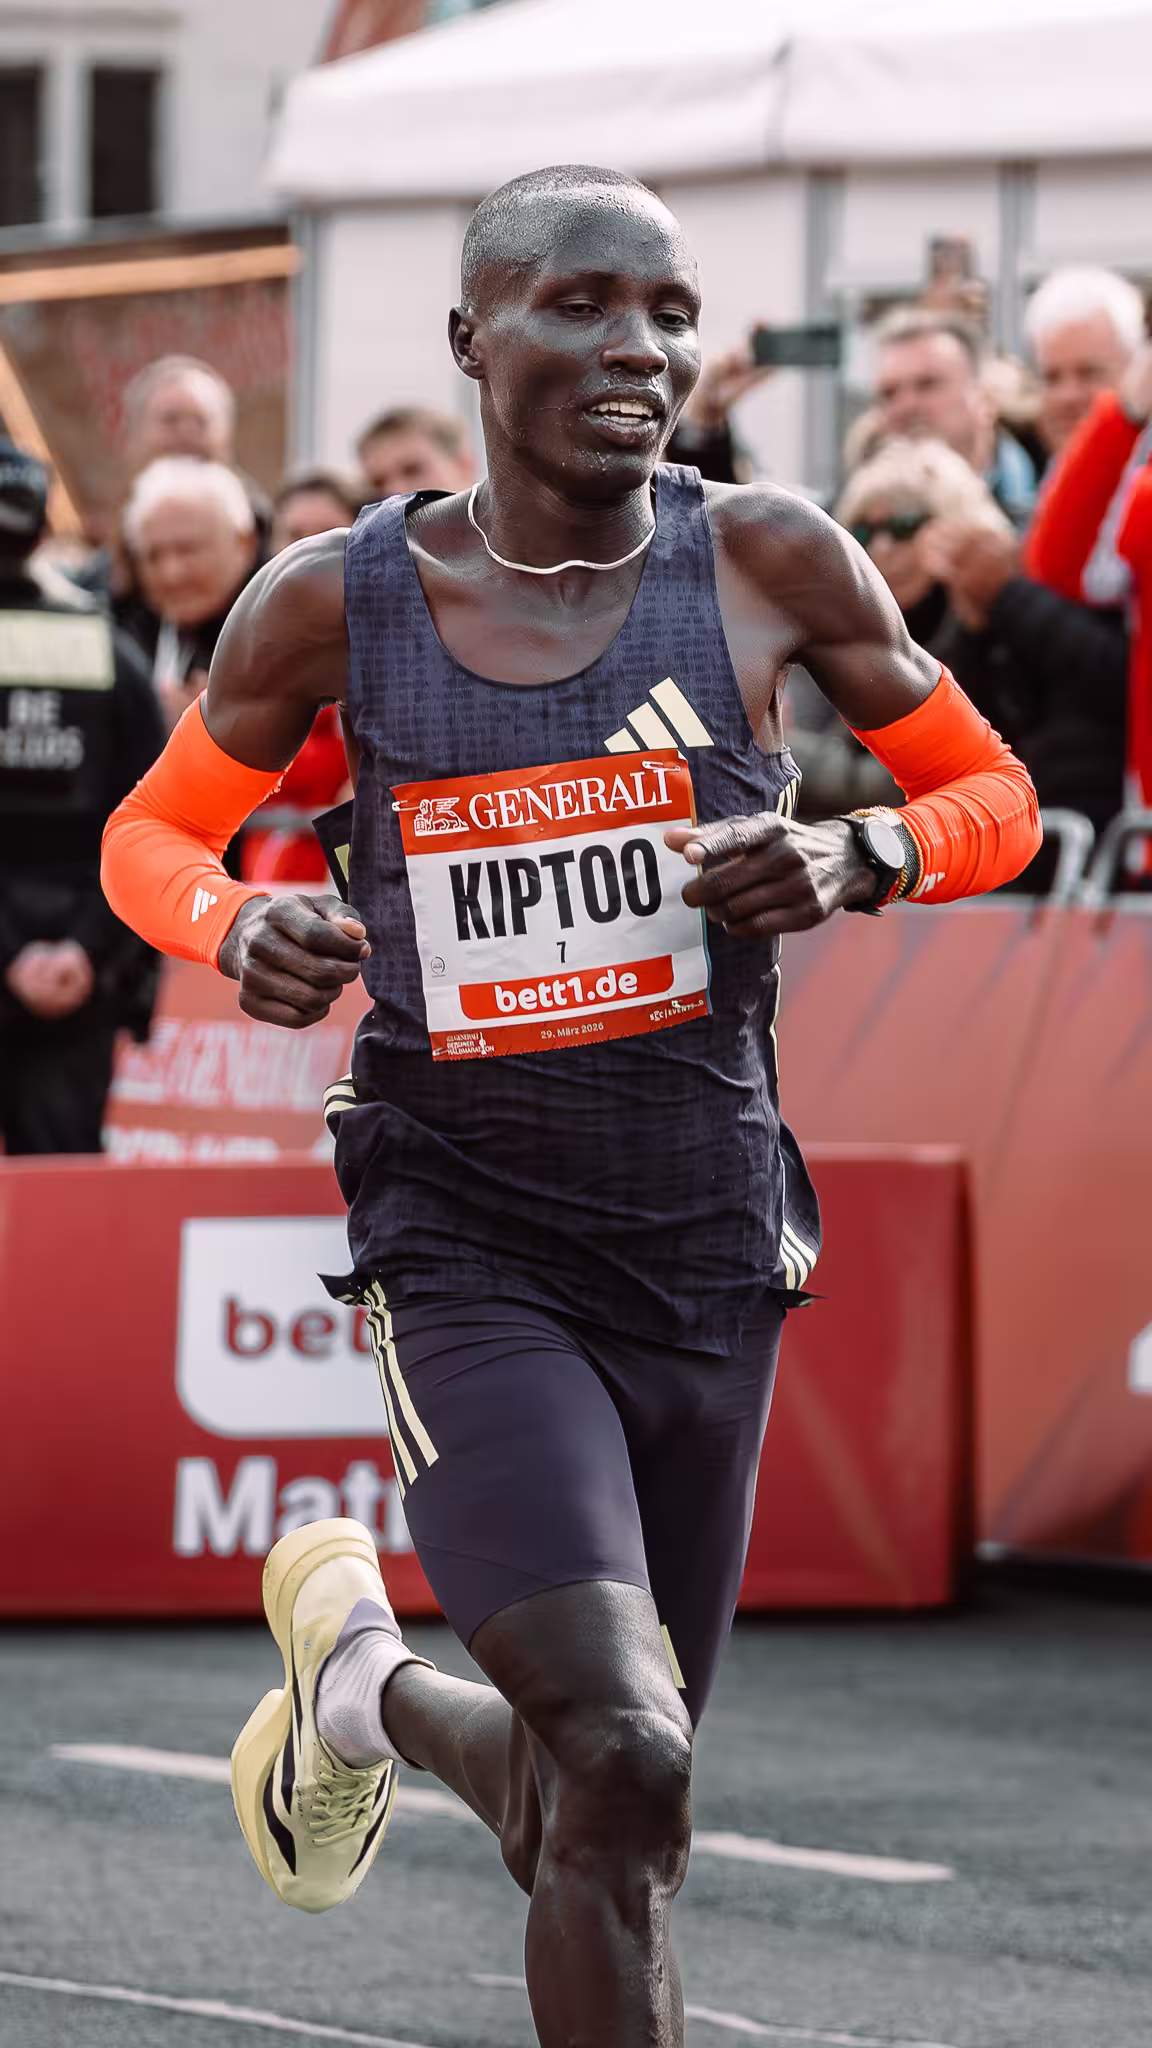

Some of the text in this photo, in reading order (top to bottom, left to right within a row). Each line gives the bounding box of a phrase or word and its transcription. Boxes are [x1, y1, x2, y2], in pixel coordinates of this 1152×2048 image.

[468, 769, 673, 831] GENERALI
[448, 837, 663, 942] KIPTOO
[556, 940, 567, 964] 7
[494, 968, 638, 1013] bett1.de
[540, 1021, 605, 1040] 29. März 2026
